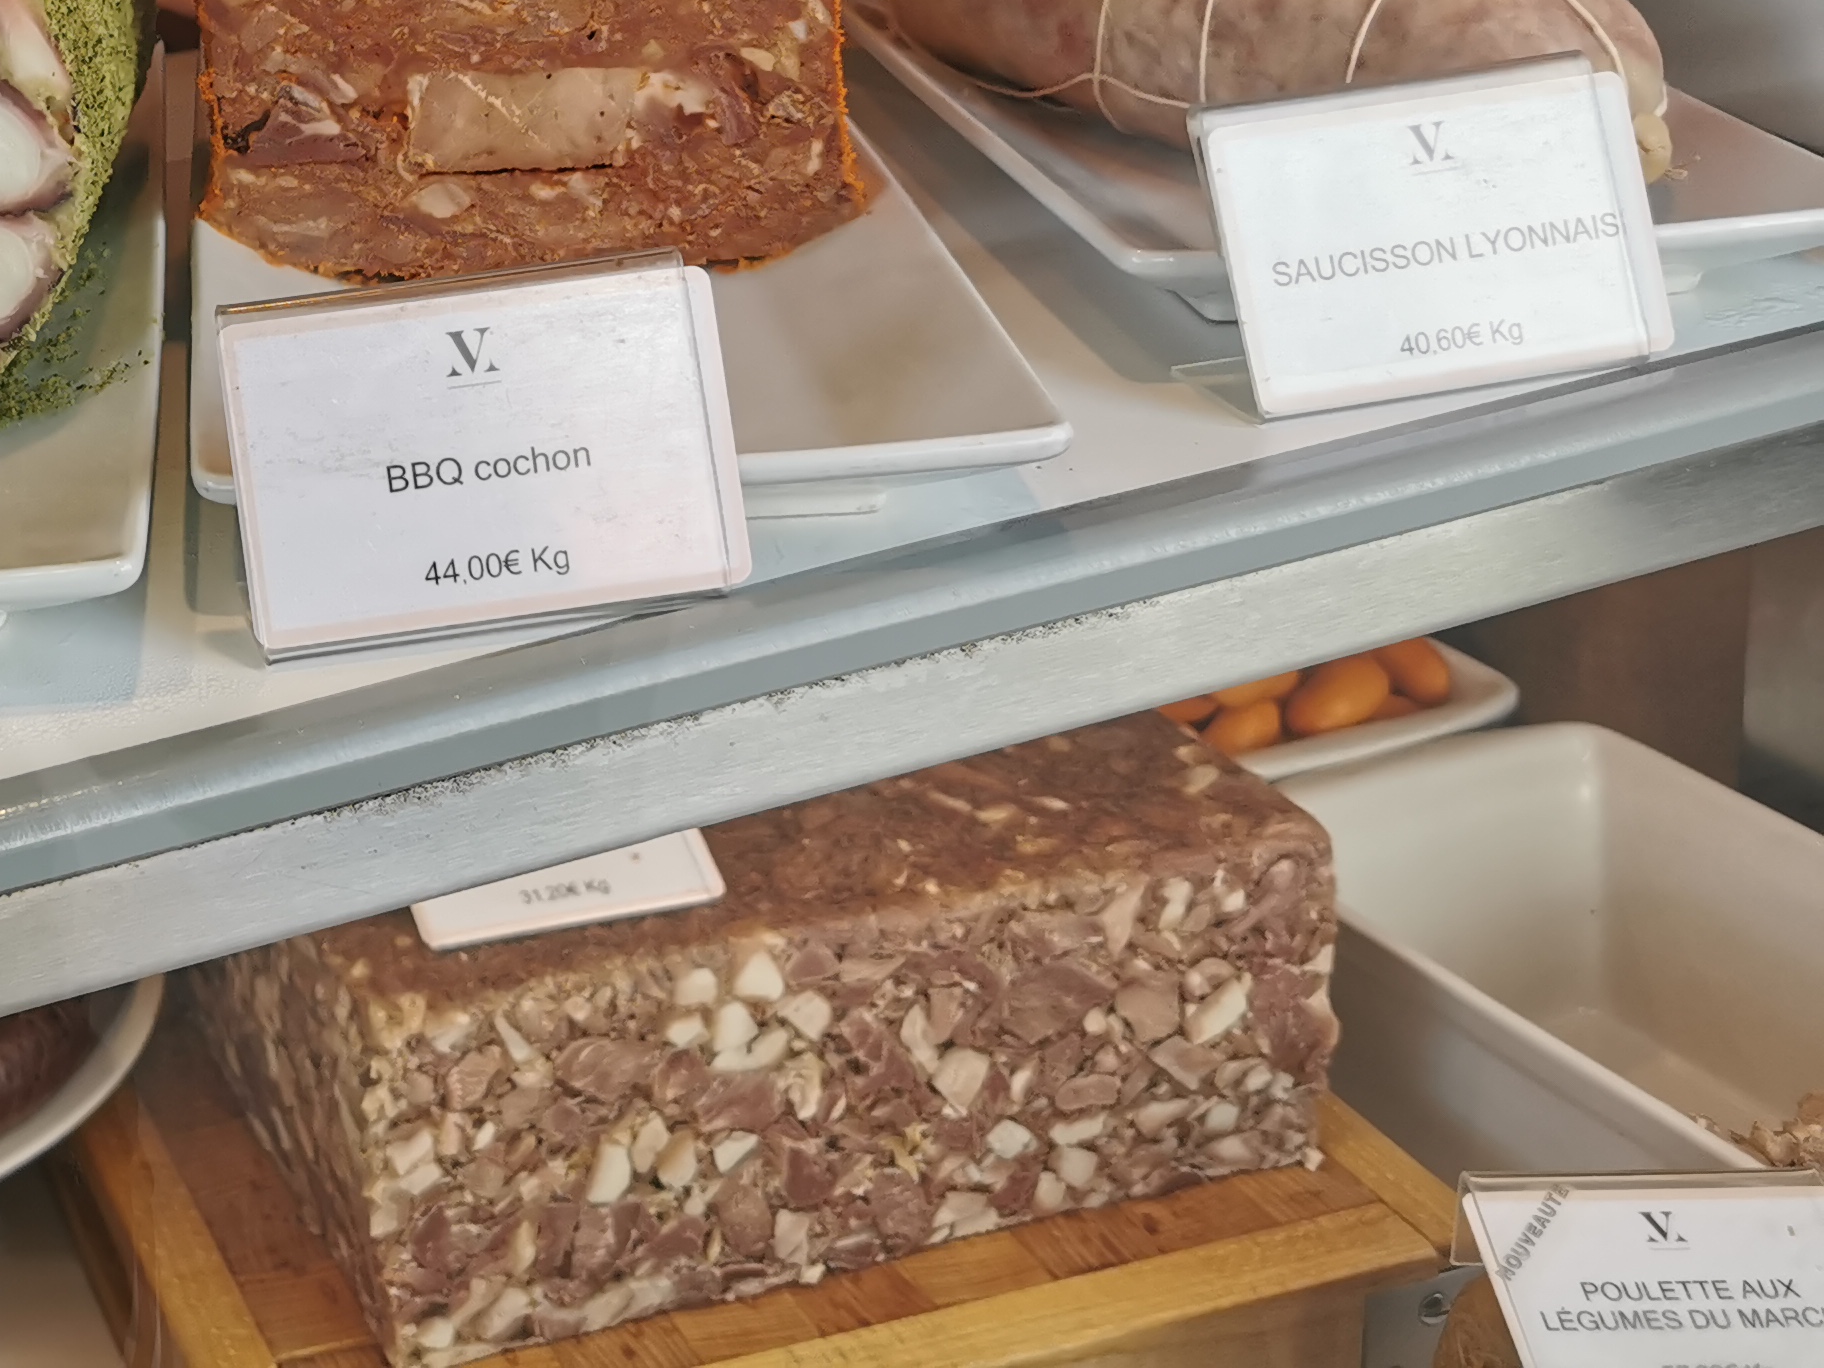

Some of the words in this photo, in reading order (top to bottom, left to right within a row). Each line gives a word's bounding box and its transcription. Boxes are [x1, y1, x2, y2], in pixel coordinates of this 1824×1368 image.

[1272, 240, 1458, 288] SAUCISSON
[1467, 212, 1621, 260] LYONNAIS
[1489, 318, 1525, 347] Kg
[385, 457, 464, 494] BBQ
[474, 444, 593, 482] cochon
[424, 549, 523, 587] 44,00€
[531, 546, 571, 575] Kg
[1580, 1280, 1734, 1302] POULETTE
[1741, 1278, 1802, 1300] AUX
[1539, 1306, 1683, 1332] LÉGUMES
[1689, 1308, 1731, 1330] DU
[1737, 1306, 1824, 1330] MARC
